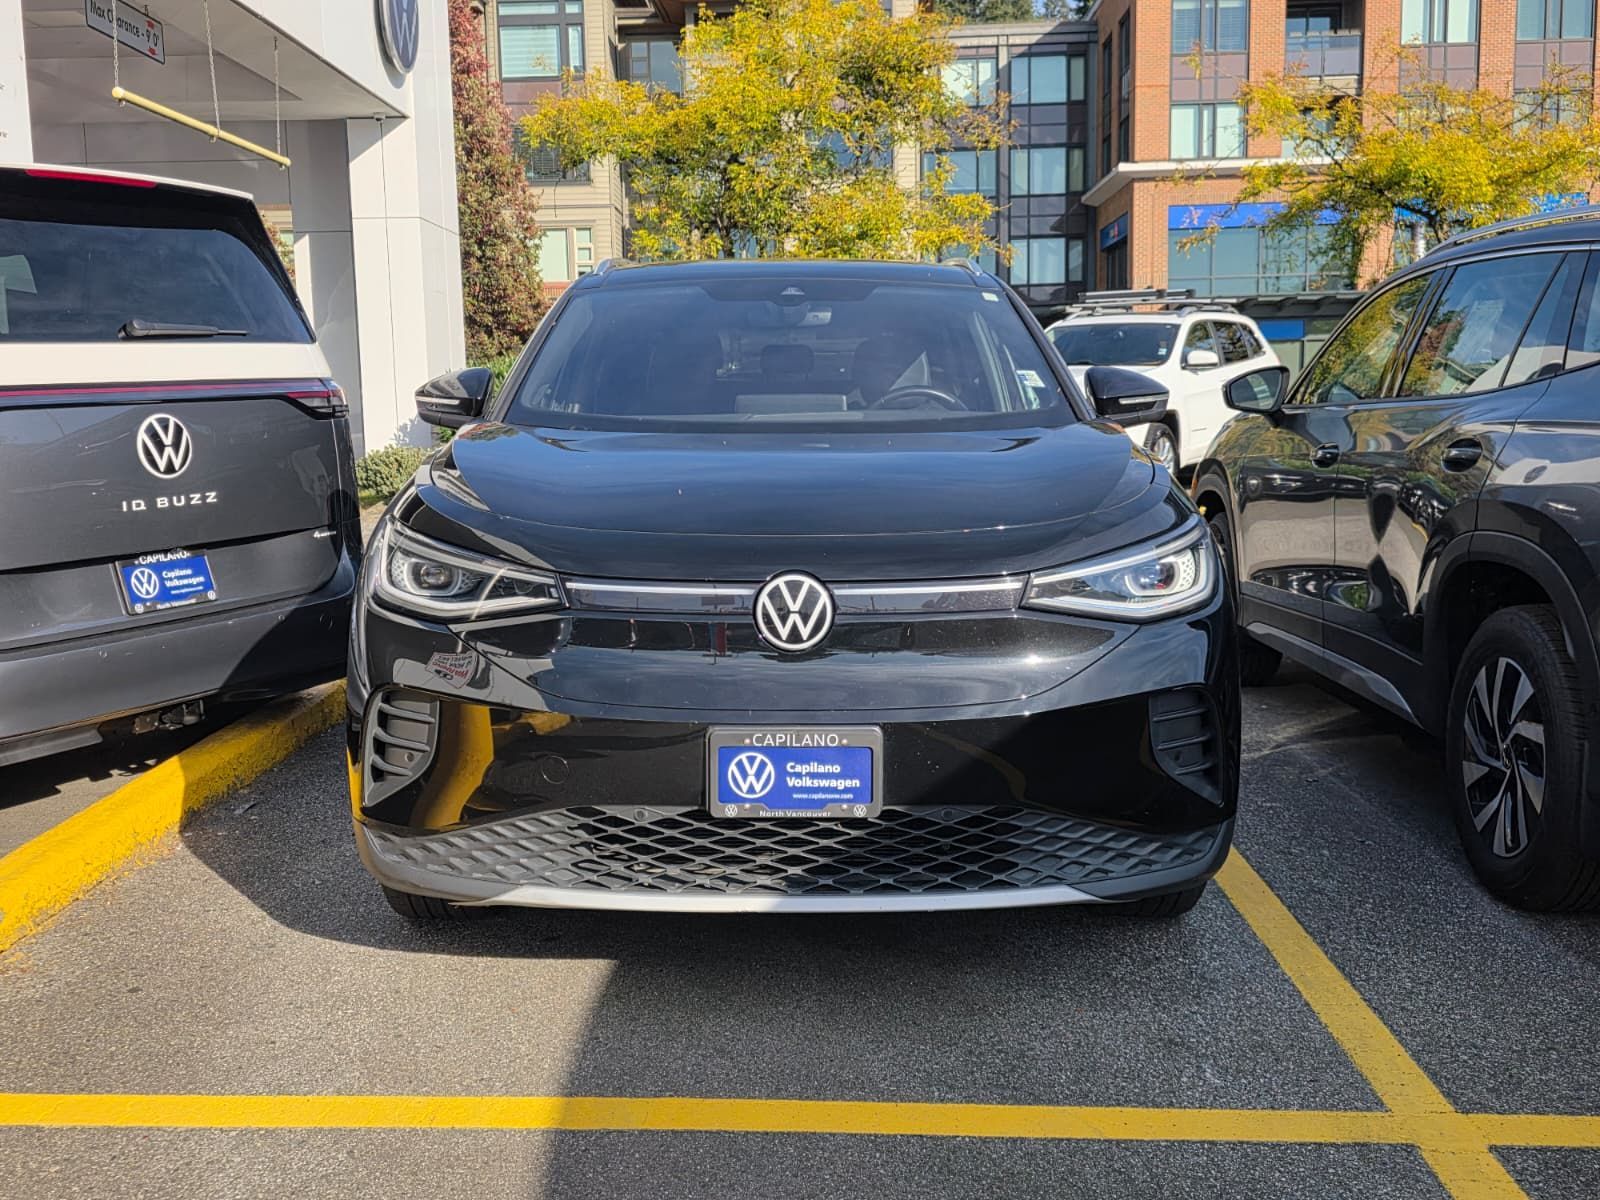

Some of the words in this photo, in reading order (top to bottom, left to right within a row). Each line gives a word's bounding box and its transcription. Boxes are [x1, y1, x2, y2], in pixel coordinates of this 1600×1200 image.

[156, 491, 217, 508] BUZZ
[139, 550, 187, 565] CAPILANO
[757, 575, 832, 651] VW
[752, 733, 839, 747] CAPILANO
[728, 752, 775, 799] VW
[786, 762, 841, 775] Capilano
[785, 776, 860, 790] Volkswagen
